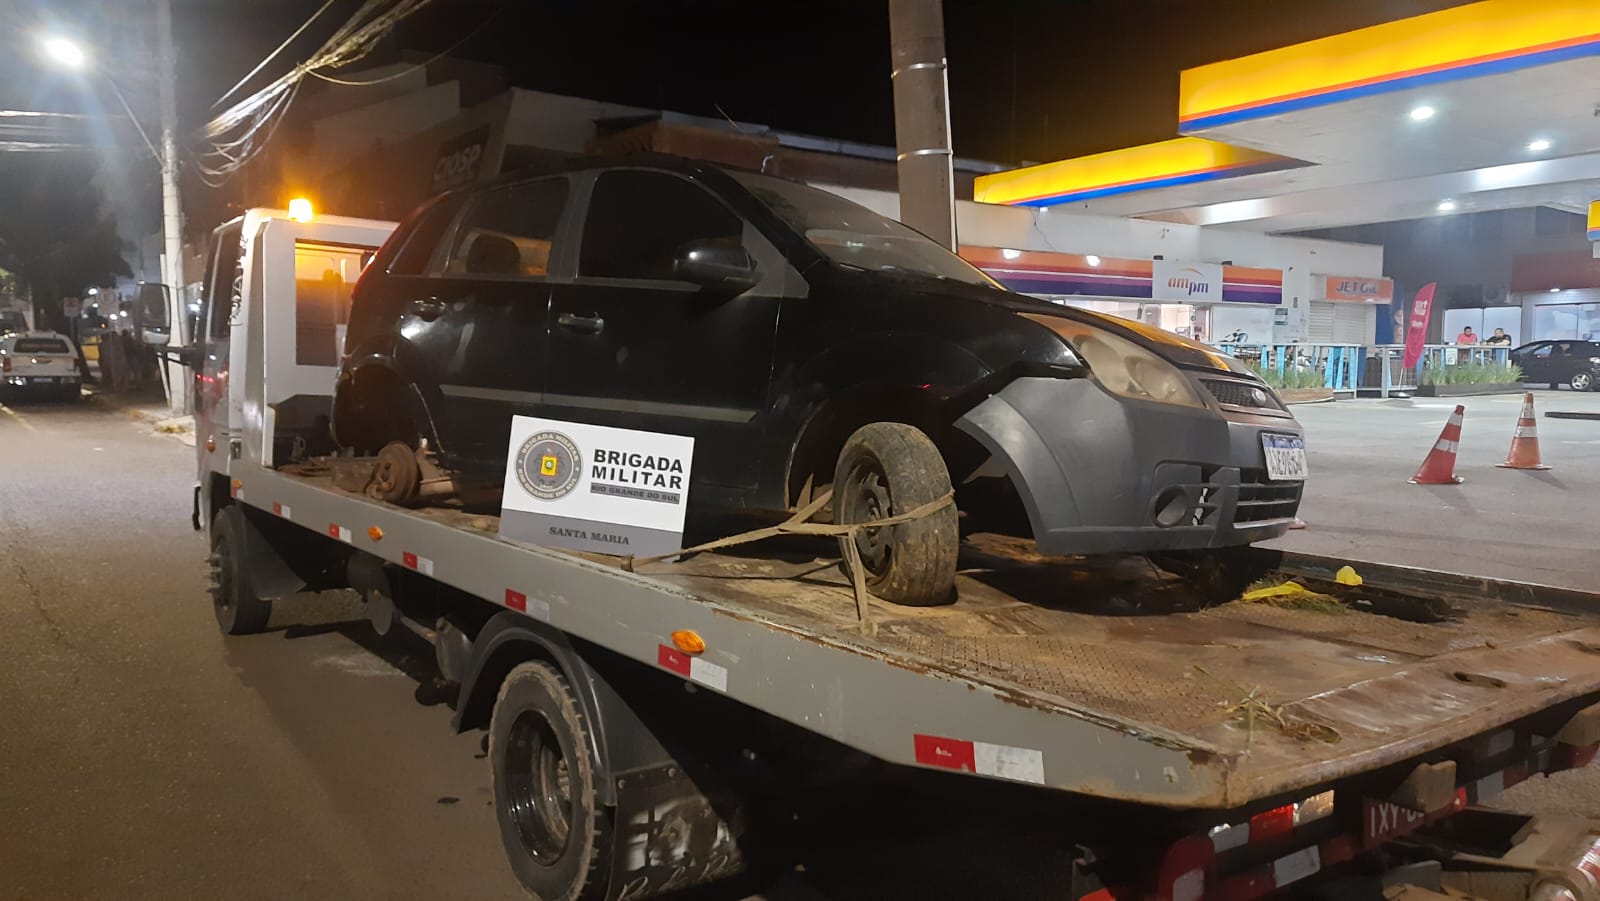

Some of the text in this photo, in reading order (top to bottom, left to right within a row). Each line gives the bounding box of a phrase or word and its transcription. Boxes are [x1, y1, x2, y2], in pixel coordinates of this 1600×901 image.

[521, 434, 579, 461] BRIGADA MILITAR
[594, 449, 683, 474] BRIGADA
[592, 465, 681, 490] MILITAR
[592, 484, 607, 493] RIO
[608, 486, 645, 498] GRANDE
[662, 494, 679, 502] SUL
[549, 526, 630, 545] SANTA MARIA
